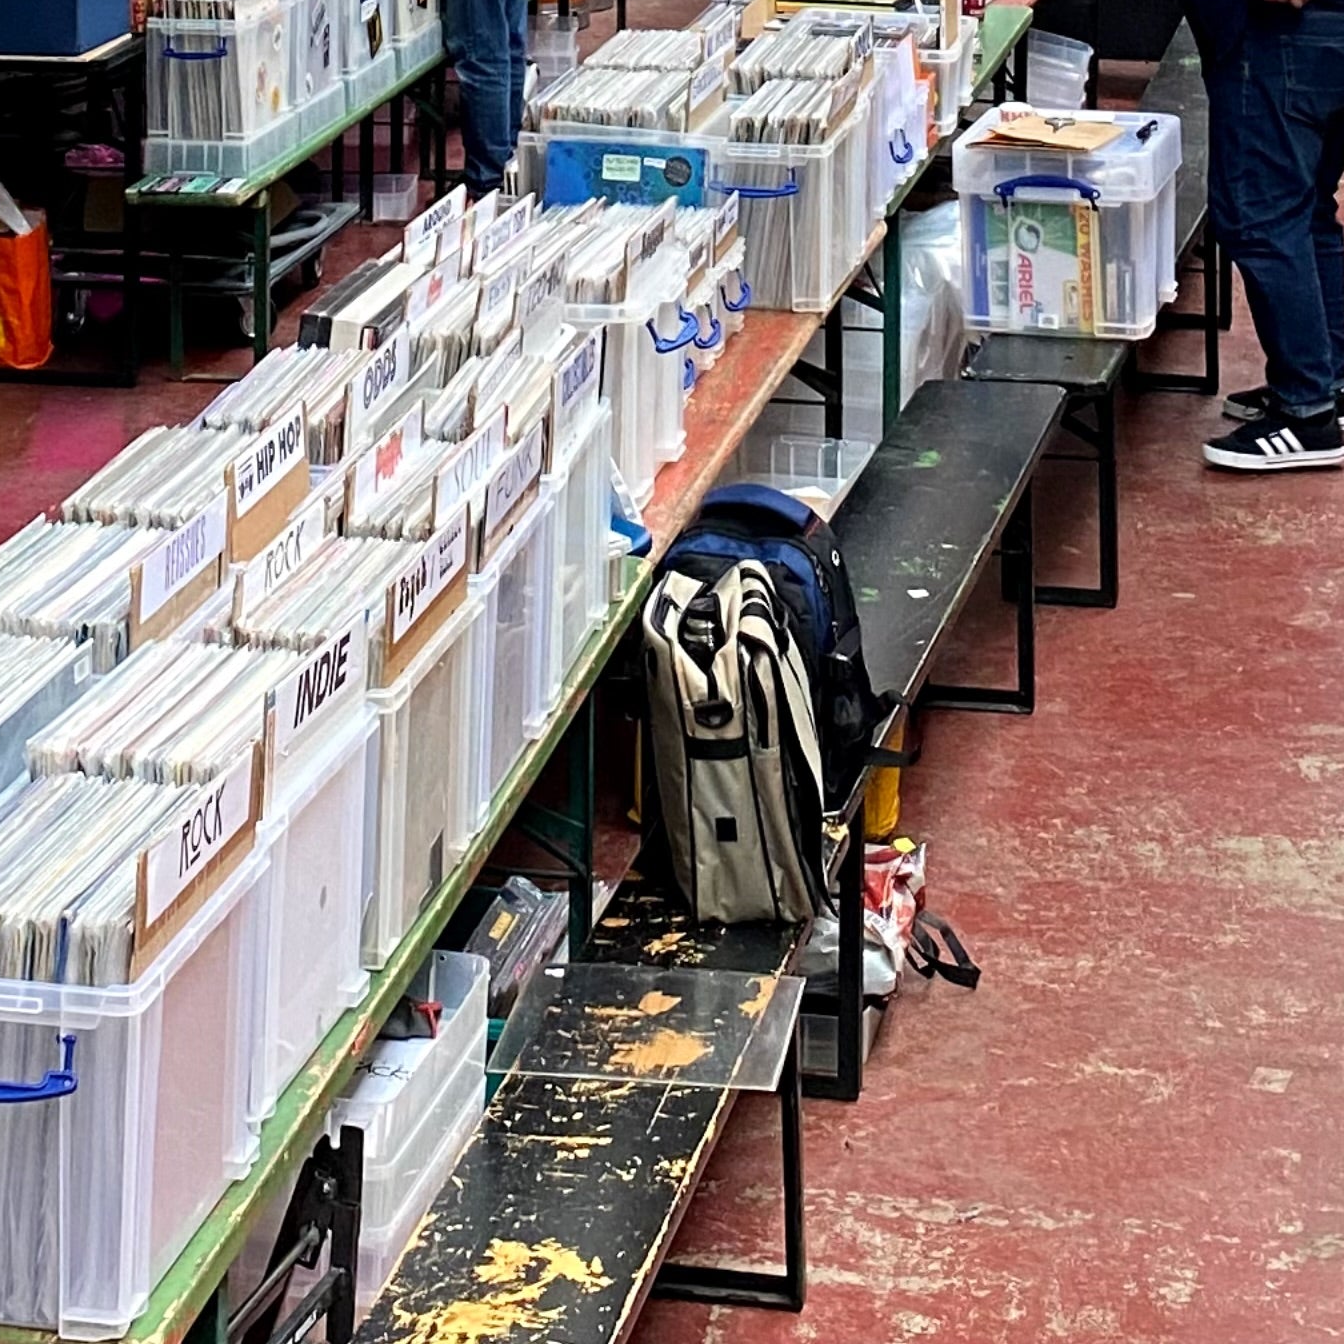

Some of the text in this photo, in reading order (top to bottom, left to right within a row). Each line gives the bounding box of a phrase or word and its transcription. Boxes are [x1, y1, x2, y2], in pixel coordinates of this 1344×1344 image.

[1017, 253, 1034, 314] ARIEL
[363, 338, 397, 411] ODDS
[256, 415, 301, 484] HIP HOP
[265, 519, 305, 592] ROCK
[293, 630, 351, 730] INDIE
[179, 778, 228, 878] ROCK
